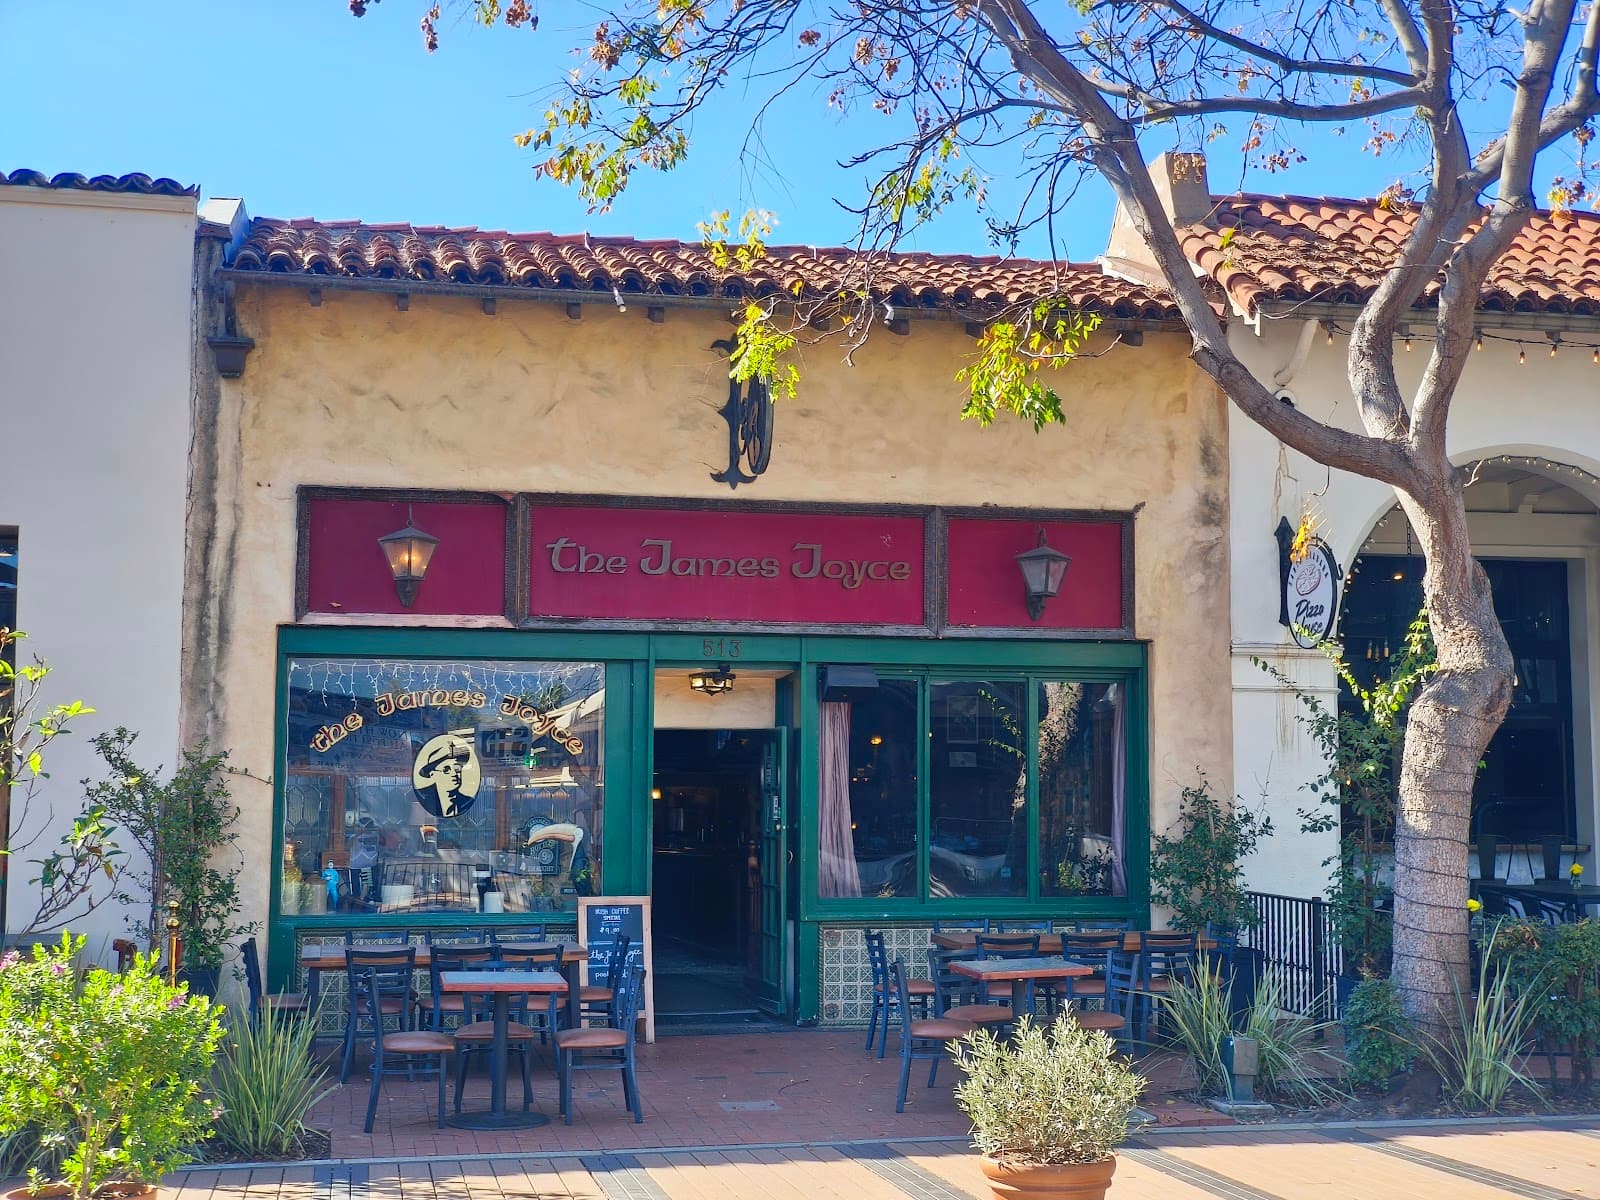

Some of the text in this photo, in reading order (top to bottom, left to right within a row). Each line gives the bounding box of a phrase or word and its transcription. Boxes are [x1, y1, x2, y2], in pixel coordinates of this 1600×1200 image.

[546, 537, 912, 589] the James Joyce
[1296, 599, 1325, 618] Pizza
[702, 639, 742, 657] 513
[310, 688, 584, 755] the James Joyce
[611, 907, 630, 915] COFFEE
